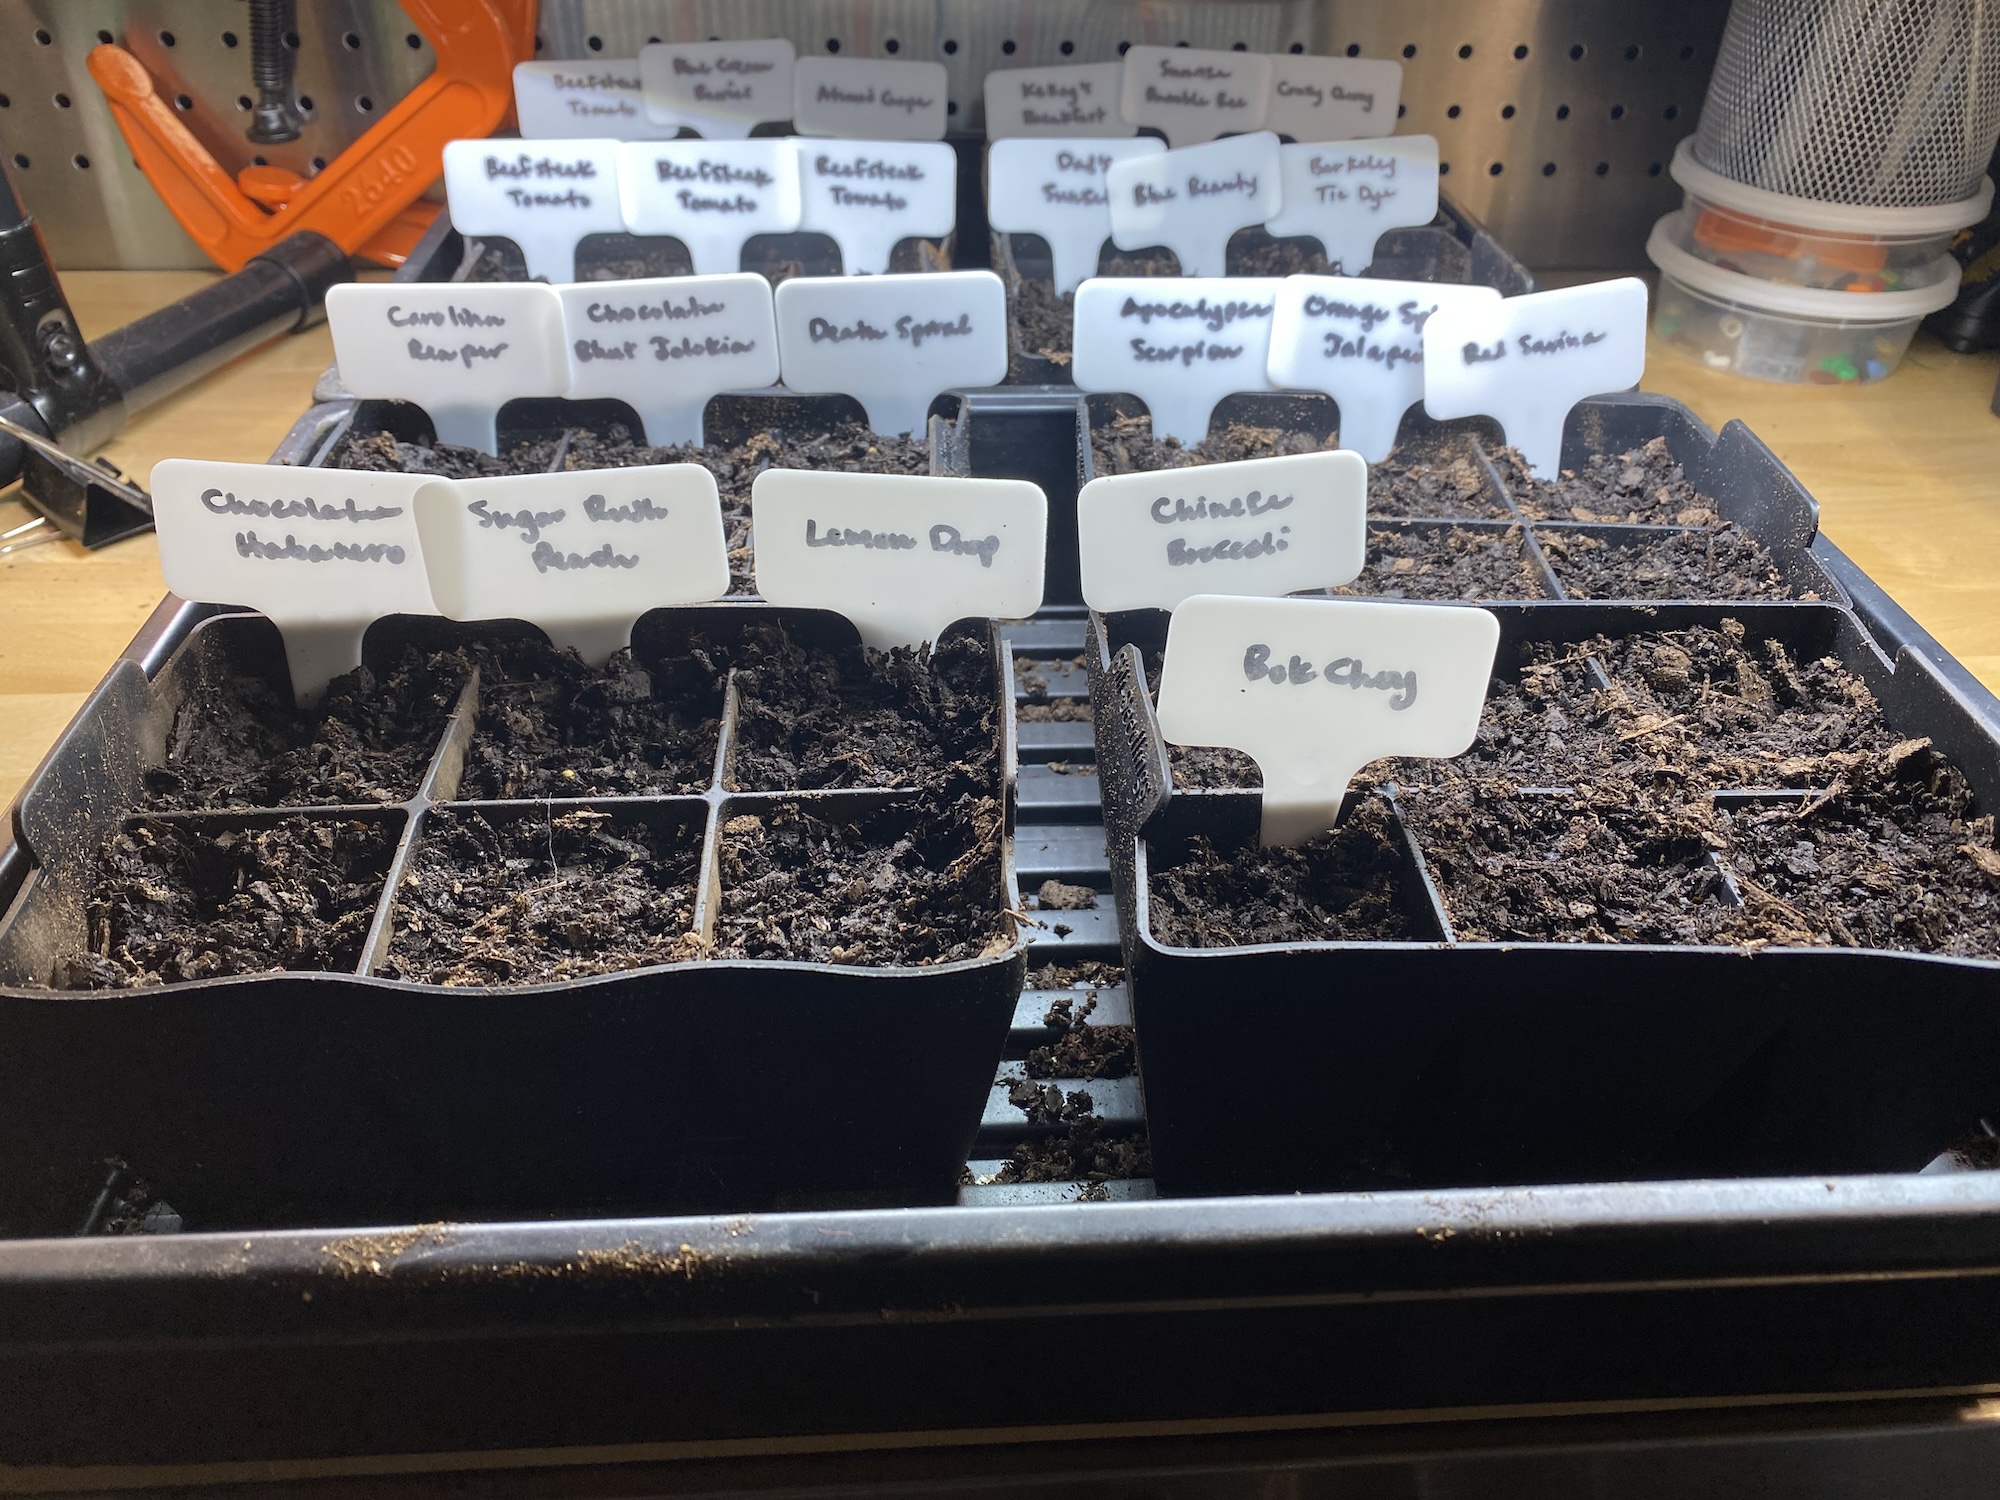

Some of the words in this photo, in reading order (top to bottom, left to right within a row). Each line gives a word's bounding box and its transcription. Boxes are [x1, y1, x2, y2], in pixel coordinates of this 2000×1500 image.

[486, 154, 597, 179] Beefsteak
[656, 161, 773, 187] Beefsteak
[815, 156, 925, 181] Beefsteak
[506, 188, 592, 208] Tomato
[677, 190, 757, 213] Tomato
[829, 186, 907, 211] Tomato
[1042, 183, 1107, 206] Sunse
[1316, 185, 1348, 203] Tie
[1359, 185, 1396, 211] Dye
[387, 305, 506, 328] Carolina
[587, 296, 725, 323] Chocolate
[1120, 297, 1272, 332] Apocalypse
[1304, 294, 1390, 332] Orange
[809, 317, 889, 343] Death
[895, 313, 973, 347] Spiral
[407, 338, 509, 369] Reaper
[1130, 337, 1244, 368] Scorpion
[1462, 341, 1508, 366] Red
[1518, 330, 1608, 356] Savina
[201, 488, 403, 523] Chocolate
[1150, 490, 1294, 525] Chinese
[467, 499, 566, 545] Sugar
[235, 530, 406, 565] Habanero
[531, 540, 640, 574] Peach
[806, 518, 918, 550] Lemon
[929, 524, 1001, 569] Drop
[1166, 525, 1291, 567] Broccoli
[1243, 643, 1319, 686] Bok
[1323, 656, 1418, 712] Choy
